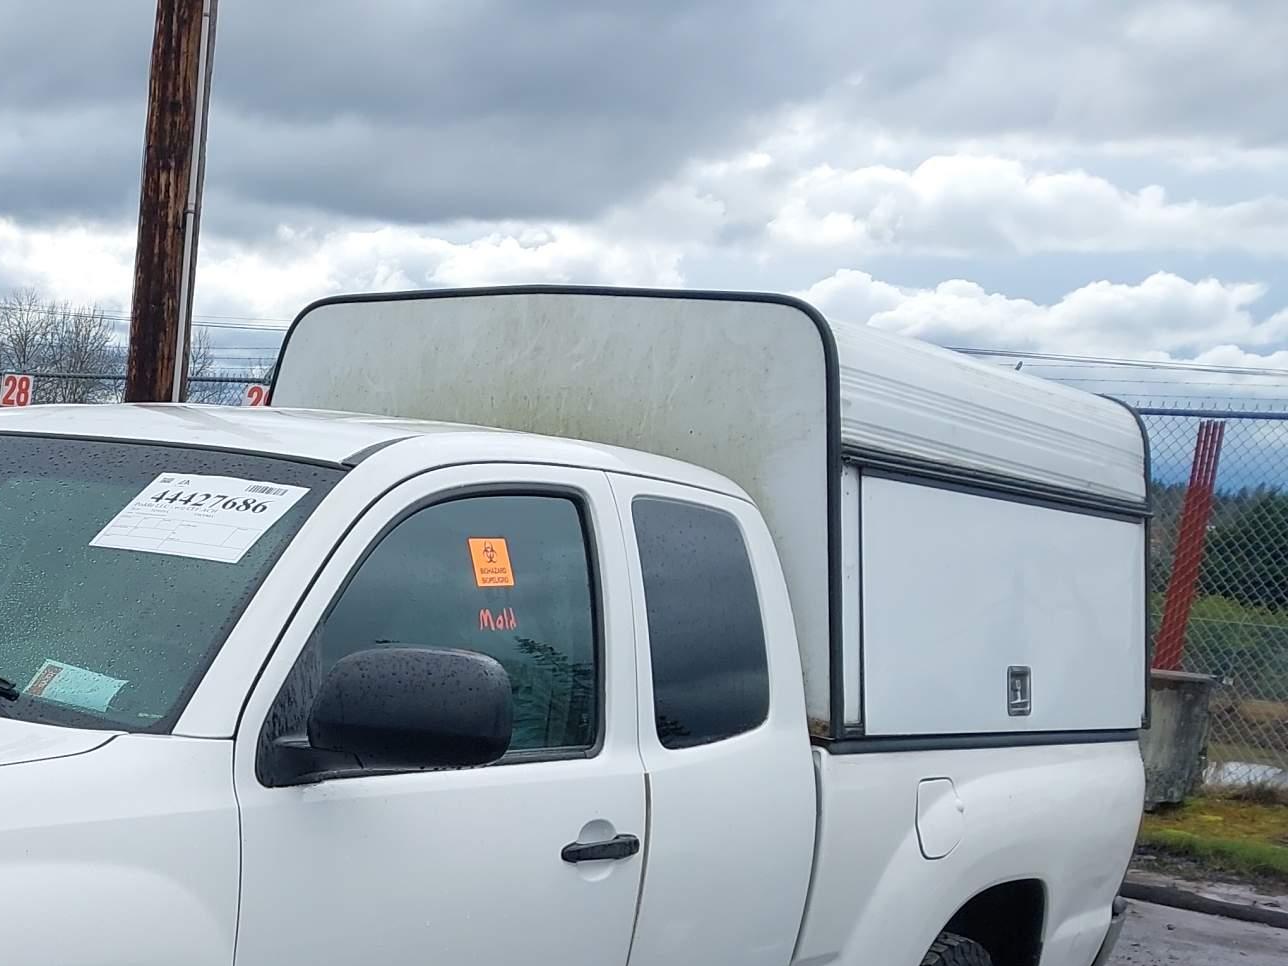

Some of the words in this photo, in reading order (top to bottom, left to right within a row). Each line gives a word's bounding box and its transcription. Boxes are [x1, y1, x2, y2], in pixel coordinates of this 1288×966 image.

[2, 375, 31, 407] 28
[150, 489, 275, 514] 44427686
[479, 607, 517, 631] Mold
